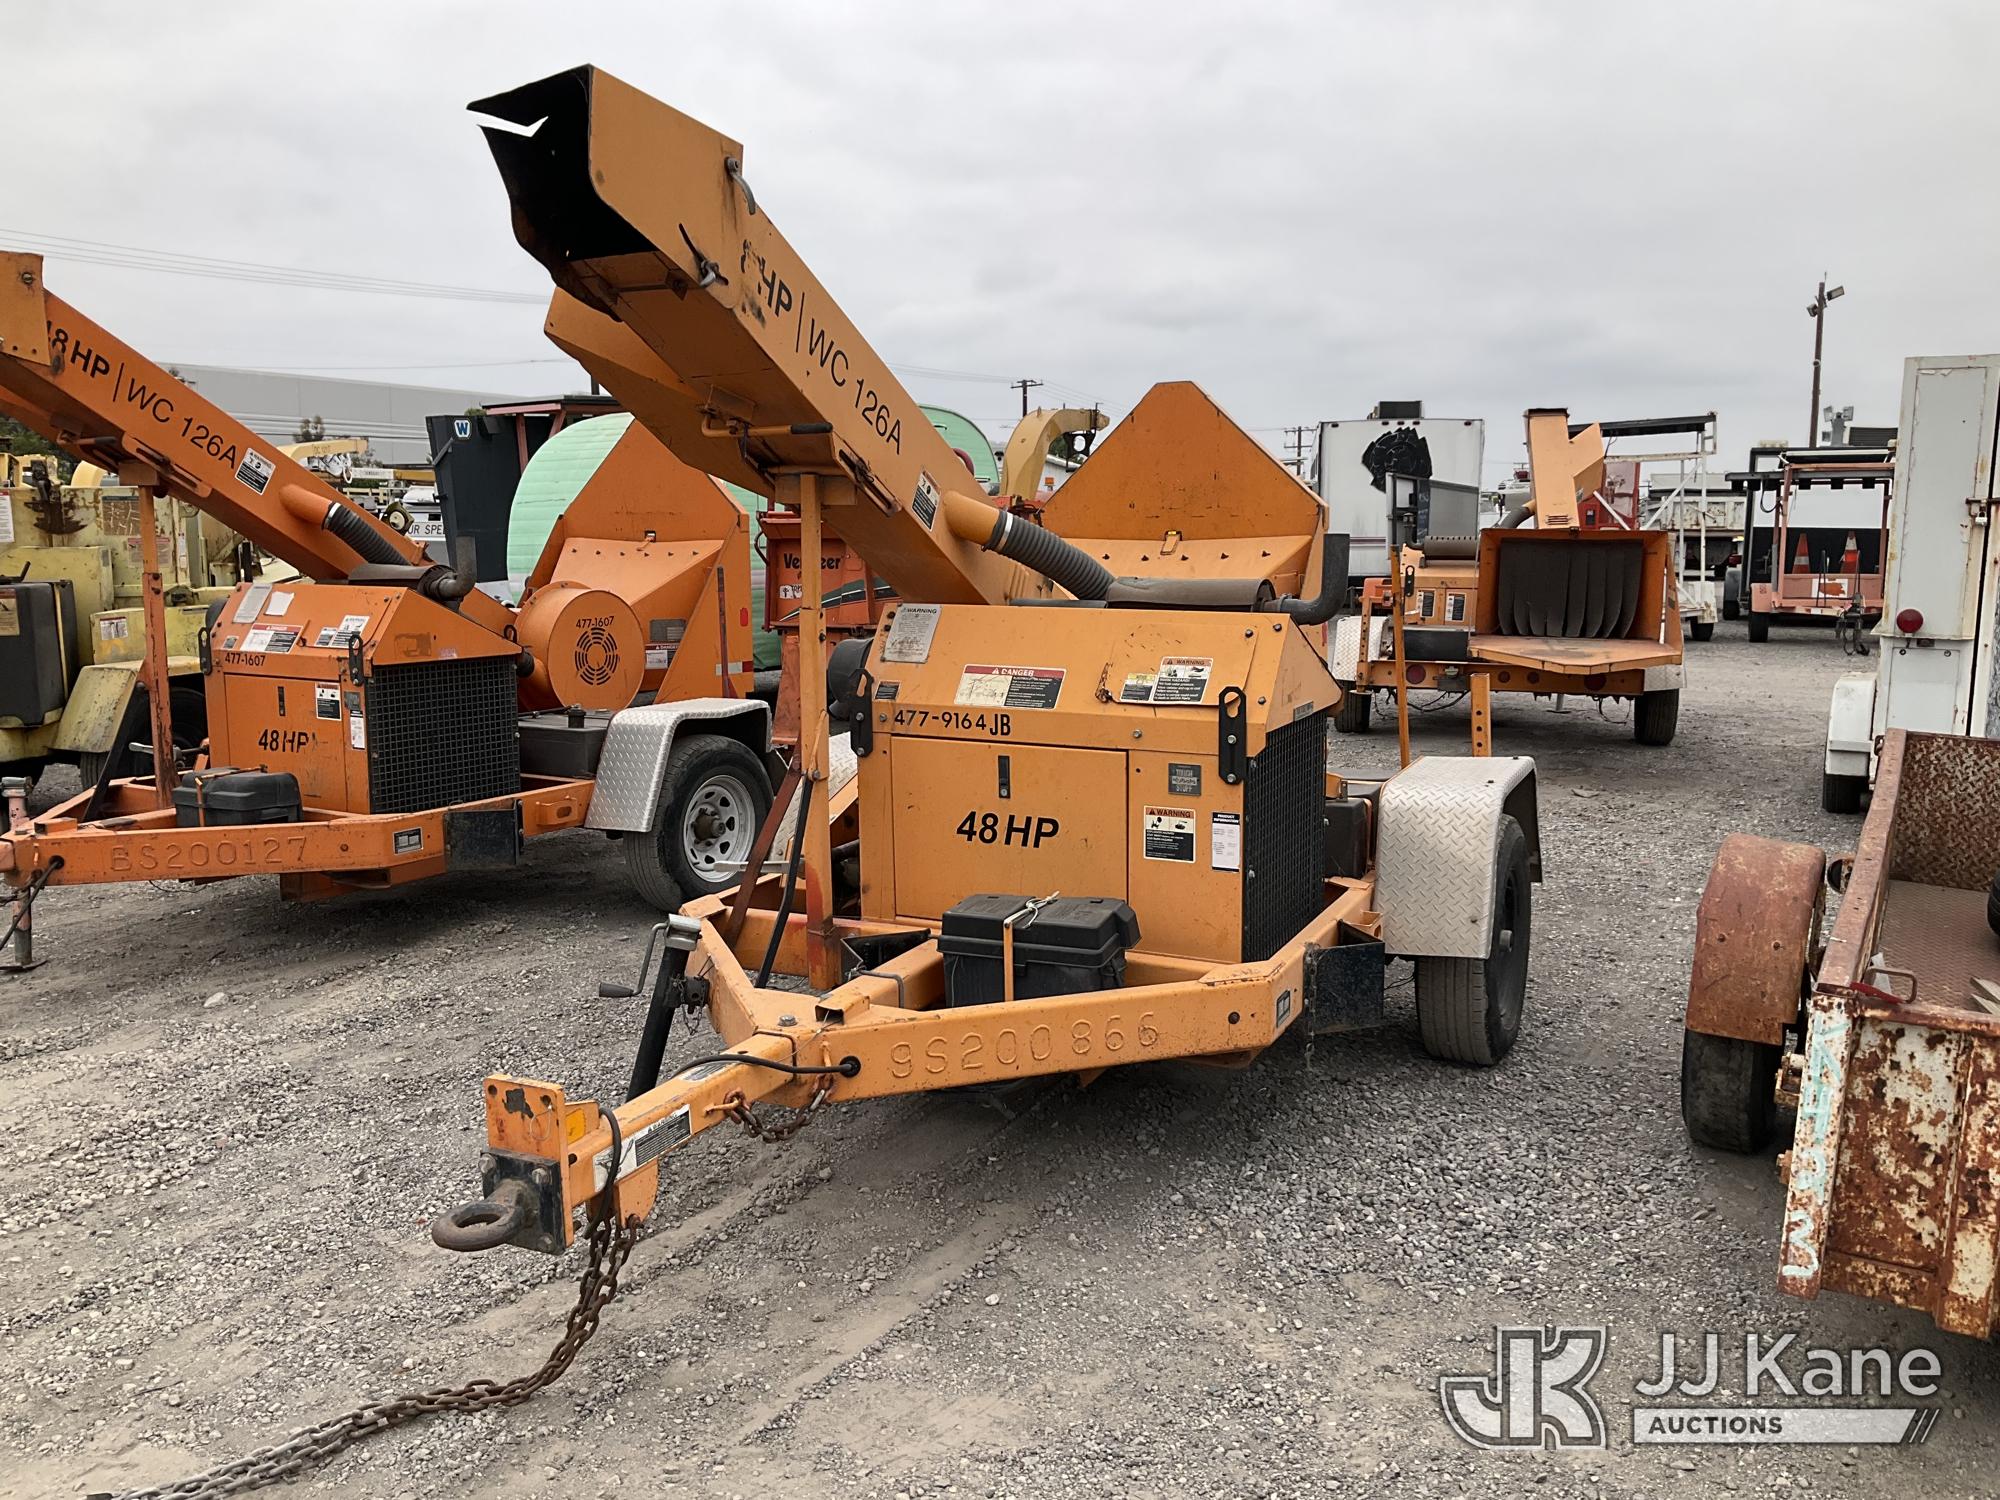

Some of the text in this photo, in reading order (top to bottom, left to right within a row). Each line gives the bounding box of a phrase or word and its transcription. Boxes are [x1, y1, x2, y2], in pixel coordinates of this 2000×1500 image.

[809, 318, 848, 387] WC
[855, 378, 902, 455] 126A
[127, 378, 174, 423] WC
[181, 417, 238, 469] 126A
[783, 552, 841, 569] Veeer
[576, 615, 615, 629] 477-1607
[225, 652, 266, 667] 477-1607
[1001, 668, 1035, 677] DANGER
[1156, 808, 1191, 818] WARNING
[110, 836, 308, 872] BS200127
